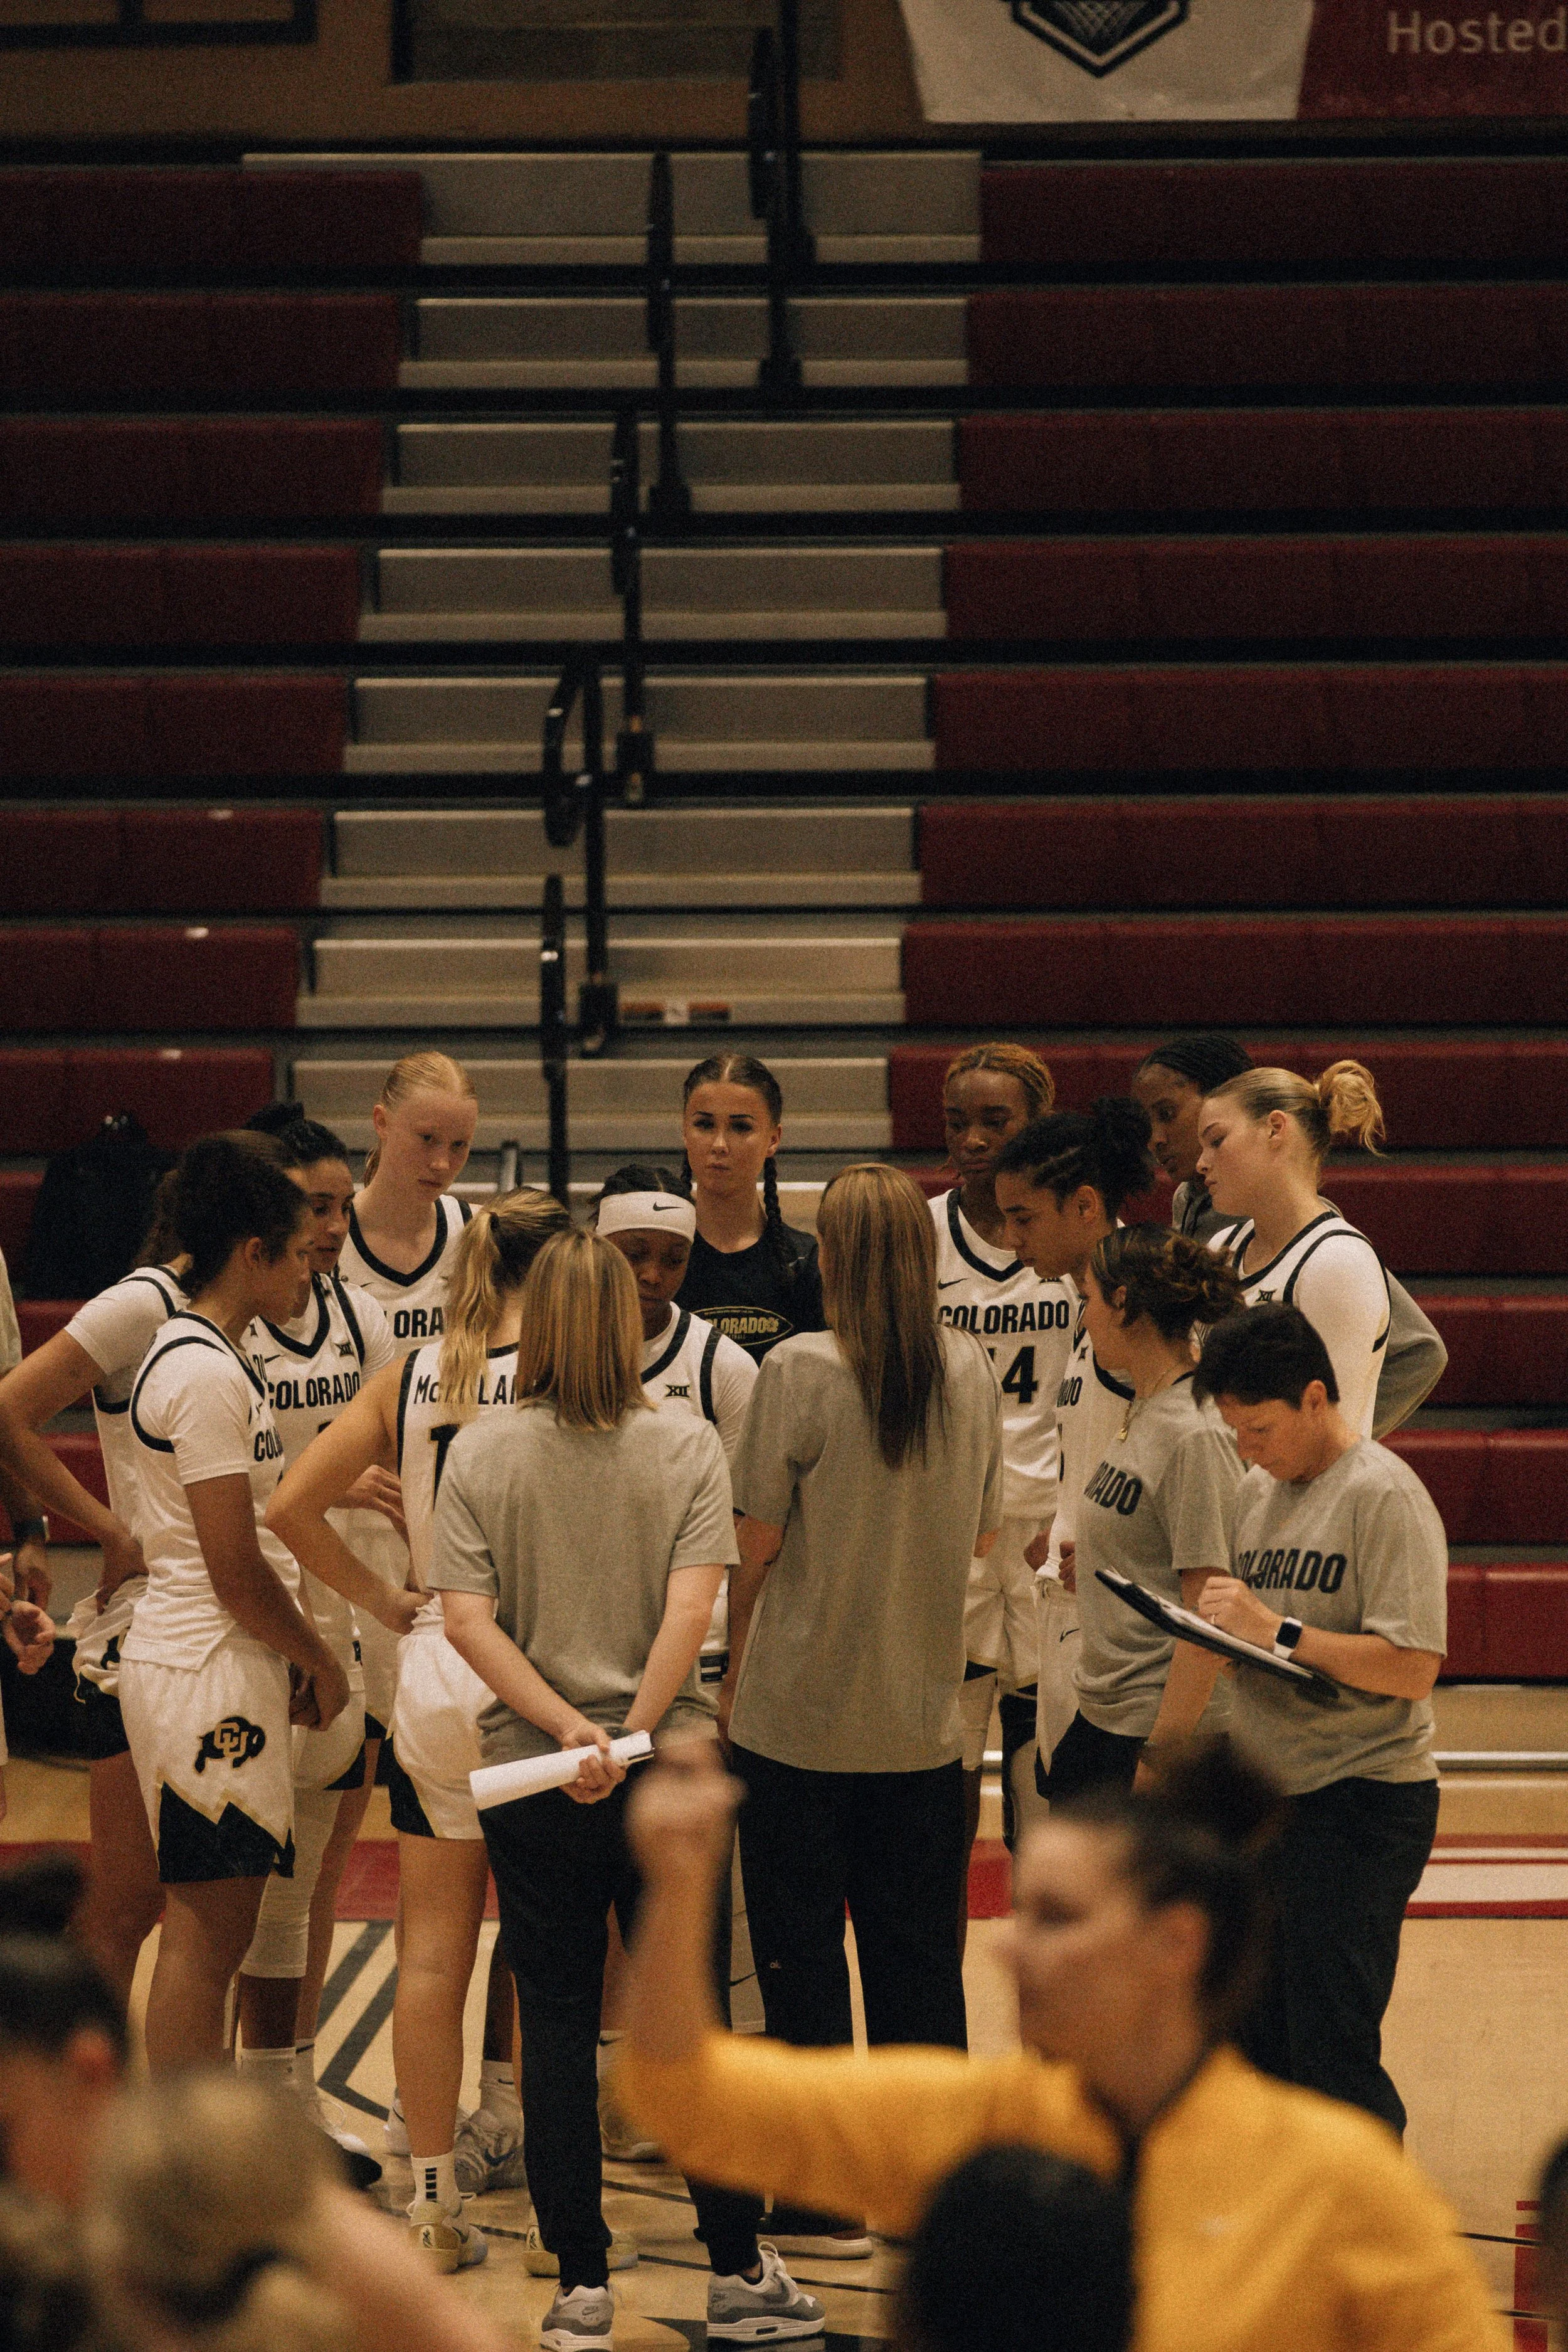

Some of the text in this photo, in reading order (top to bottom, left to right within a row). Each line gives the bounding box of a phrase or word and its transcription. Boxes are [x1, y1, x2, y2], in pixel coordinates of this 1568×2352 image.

[1387, 5, 1568, 54] Hosted
[383, 1306, 445, 1338] ORA
[936, 1300, 1069, 1335] COLORADO
[986, 1345, 1039, 1404] 4
